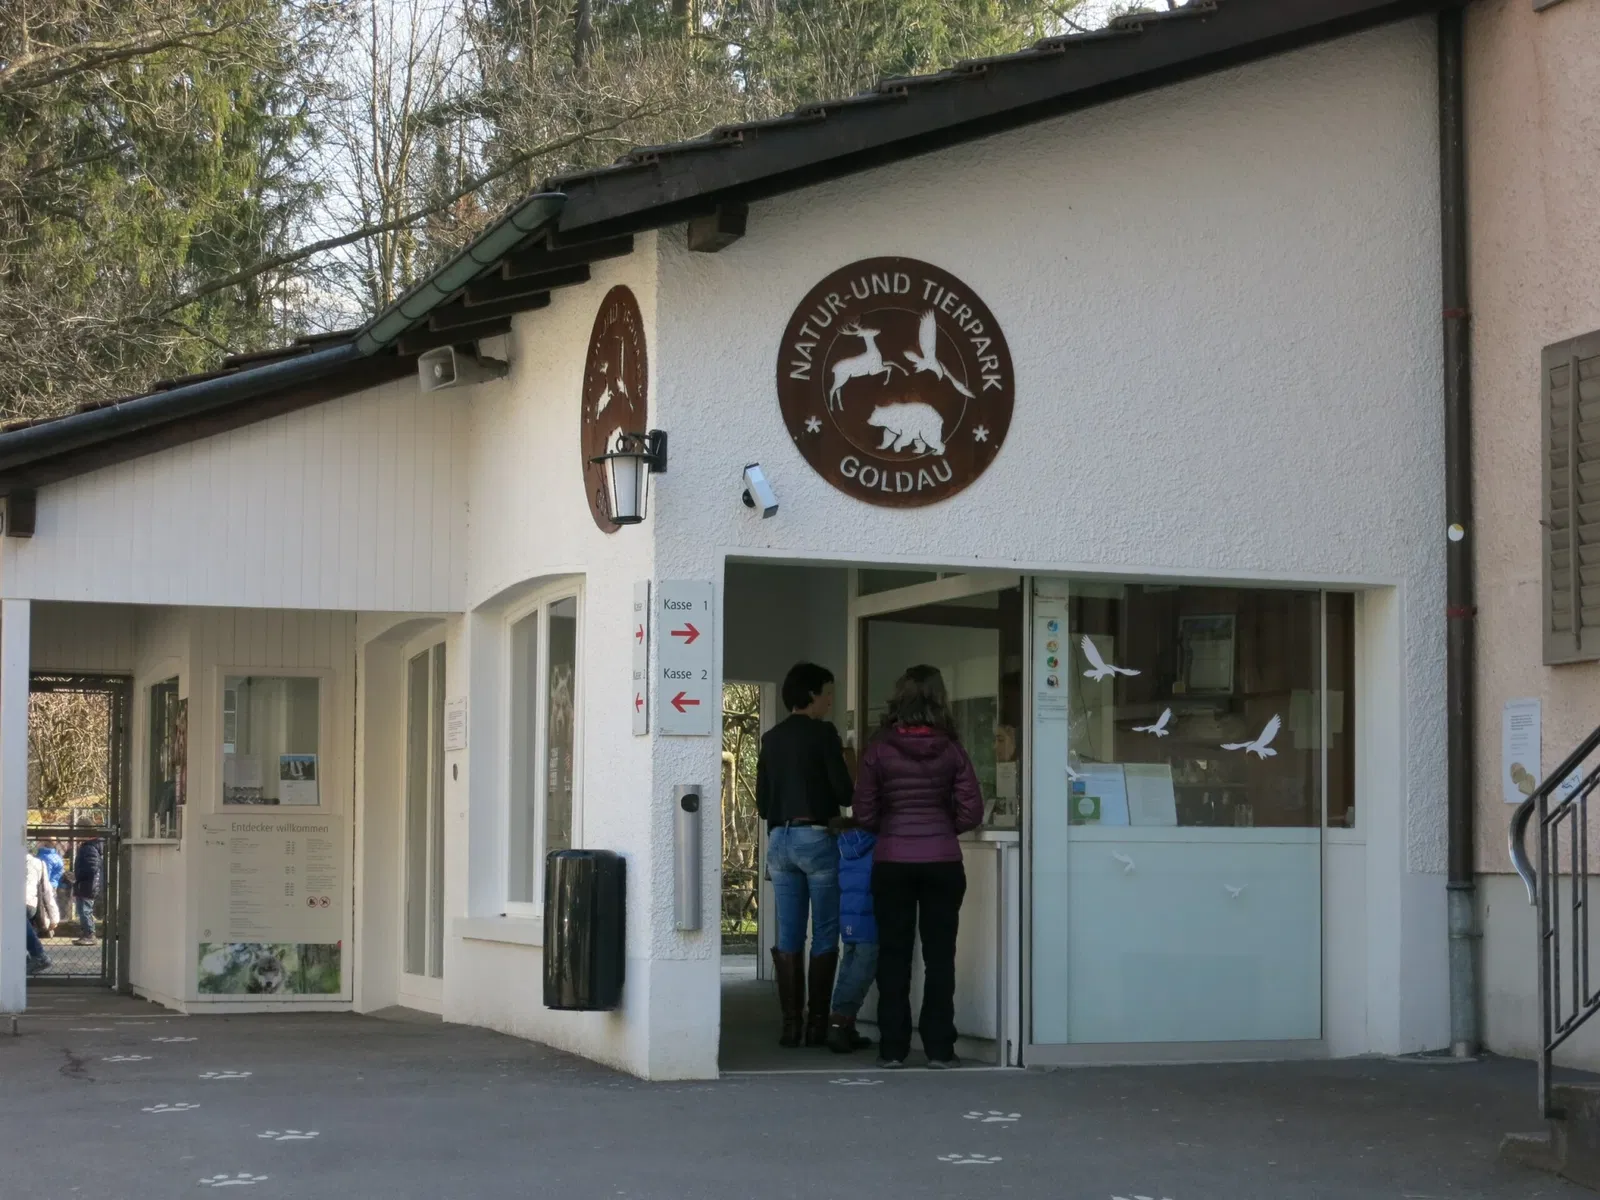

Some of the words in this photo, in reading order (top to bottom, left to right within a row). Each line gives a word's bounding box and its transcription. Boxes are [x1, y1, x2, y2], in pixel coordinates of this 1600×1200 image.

[922, 278, 1003, 392] TIERPARK
[839, 455, 953, 493] GOLDAU
[663, 598, 693, 611] Kasse
[703, 600, 708, 611] 1
[663, 667, 693, 680] Kasse
[701, 669, 708, 680] 2
[231, 822, 273, 833] Entdecker
[276, 823, 329, 834] willkommen
